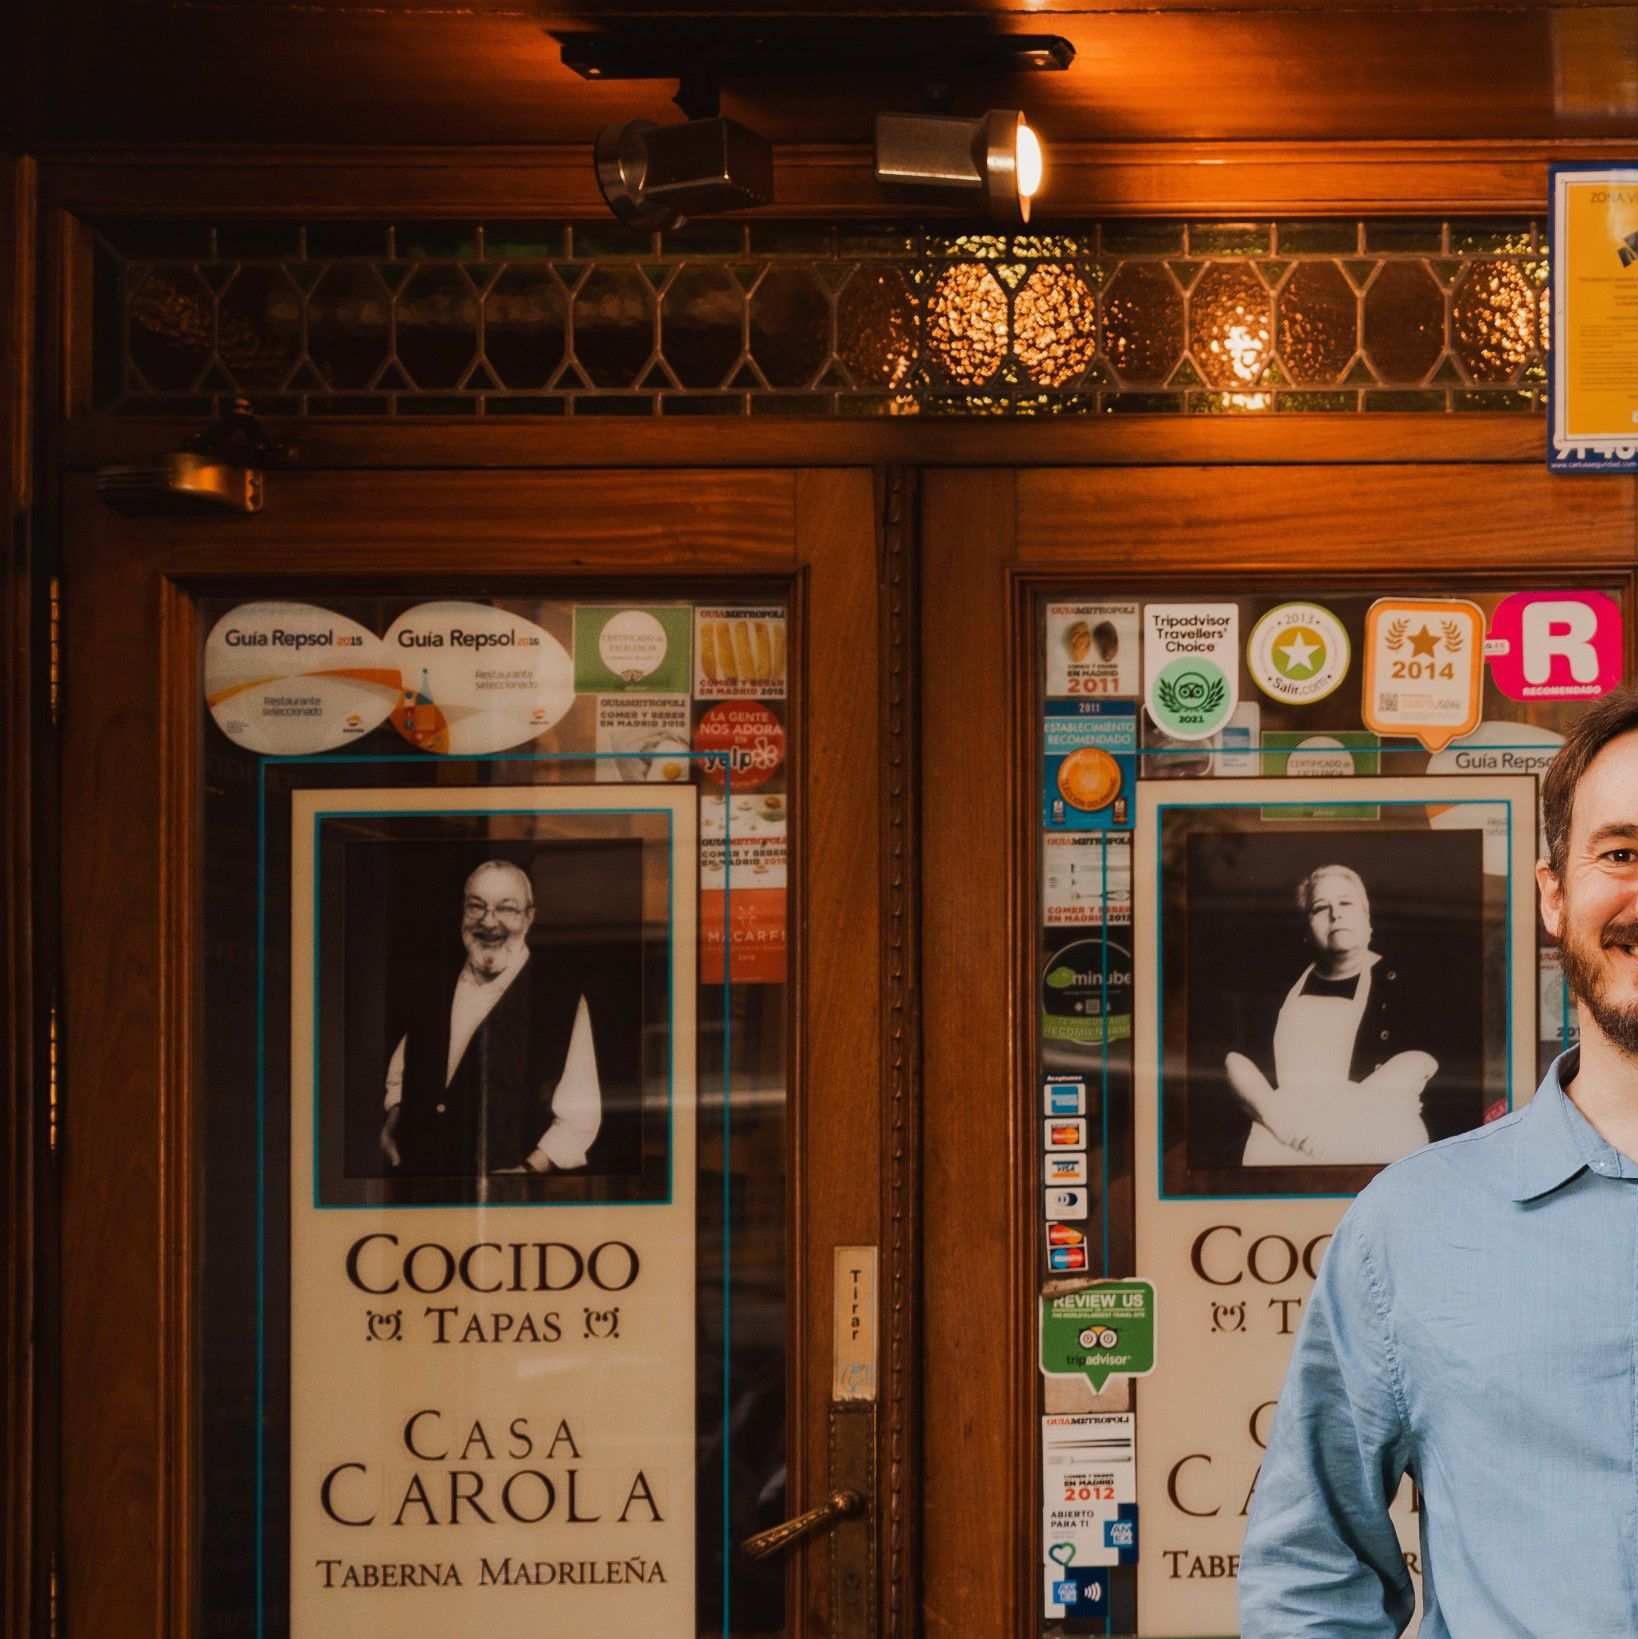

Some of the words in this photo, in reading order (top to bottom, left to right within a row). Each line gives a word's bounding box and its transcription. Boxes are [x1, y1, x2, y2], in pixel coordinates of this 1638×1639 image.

[1152, 614, 1231, 630] Tripadvisor
[1284, 612, 1314, 626] 2013
[225, 628, 269, 647] Guía
[271, 628, 334, 650] Repsol
[398, 628, 444, 648] Guía
[449, 628, 516, 652] Repsol
[1156, 628, 1228, 640] Travellers'
[1165, 640, 1216, 653] Choice
[1522, 600, 1600, 685] R
[1082, 669, 1118, 677] MADRID
[1390, 661, 1455, 681] 2014
[717, 687, 758, 696] MADRID
[1067, 678, 1120, 694] 2011
[1522, 685, 1602, 697] RECOMENDADO
[1079, 702, 1101, 713] 2011
[600, 711, 638, 719] COMER
[710, 711, 726, 722] LA
[728, 711, 769, 722] GENTE
[1178, 715, 1205, 724] 2021
[600, 720, 614, 729] EN
[617, 720, 658, 729] MADRID
[699, 723, 731, 735] NOS
[732, 723, 783, 735] ADORA
[1047, 733, 1132, 745] RECOMENDADO
[1455, 751, 1498, 770] Guía
[1501, 751, 1554, 774] Repso
[702, 850, 740, 859] COMR
[1072, 970, 1131, 986] minbe
[345, 1232, 641, 1296] COCIDO
[850, 1269, 862, 1341] Tirar
[1054, 1293, 1116, 1308] REVIEW
[1122, 1293, 1144, 1308] US
[423, 1305, 563, 1344] TAPAS
[1066, 1353, 1128, 1368] tripadvisor
[402, 1409, 583, 1462] CASA
[320, 1461, 665, 1527] CAROLA
[1064, 1487, 1115, 1501] 2012
[1050, 1509, 1095, 1519] ABIERTO
[1050, 1519, 1077, 1528] PARA
[1080, 1519, 1089, 1528] TI
[1162, 1549, 1241, 1579] TABE
[316, 1558, 464, 1589] TABERNA
[479, 1555, 668, 1586] MADRILEÑA
